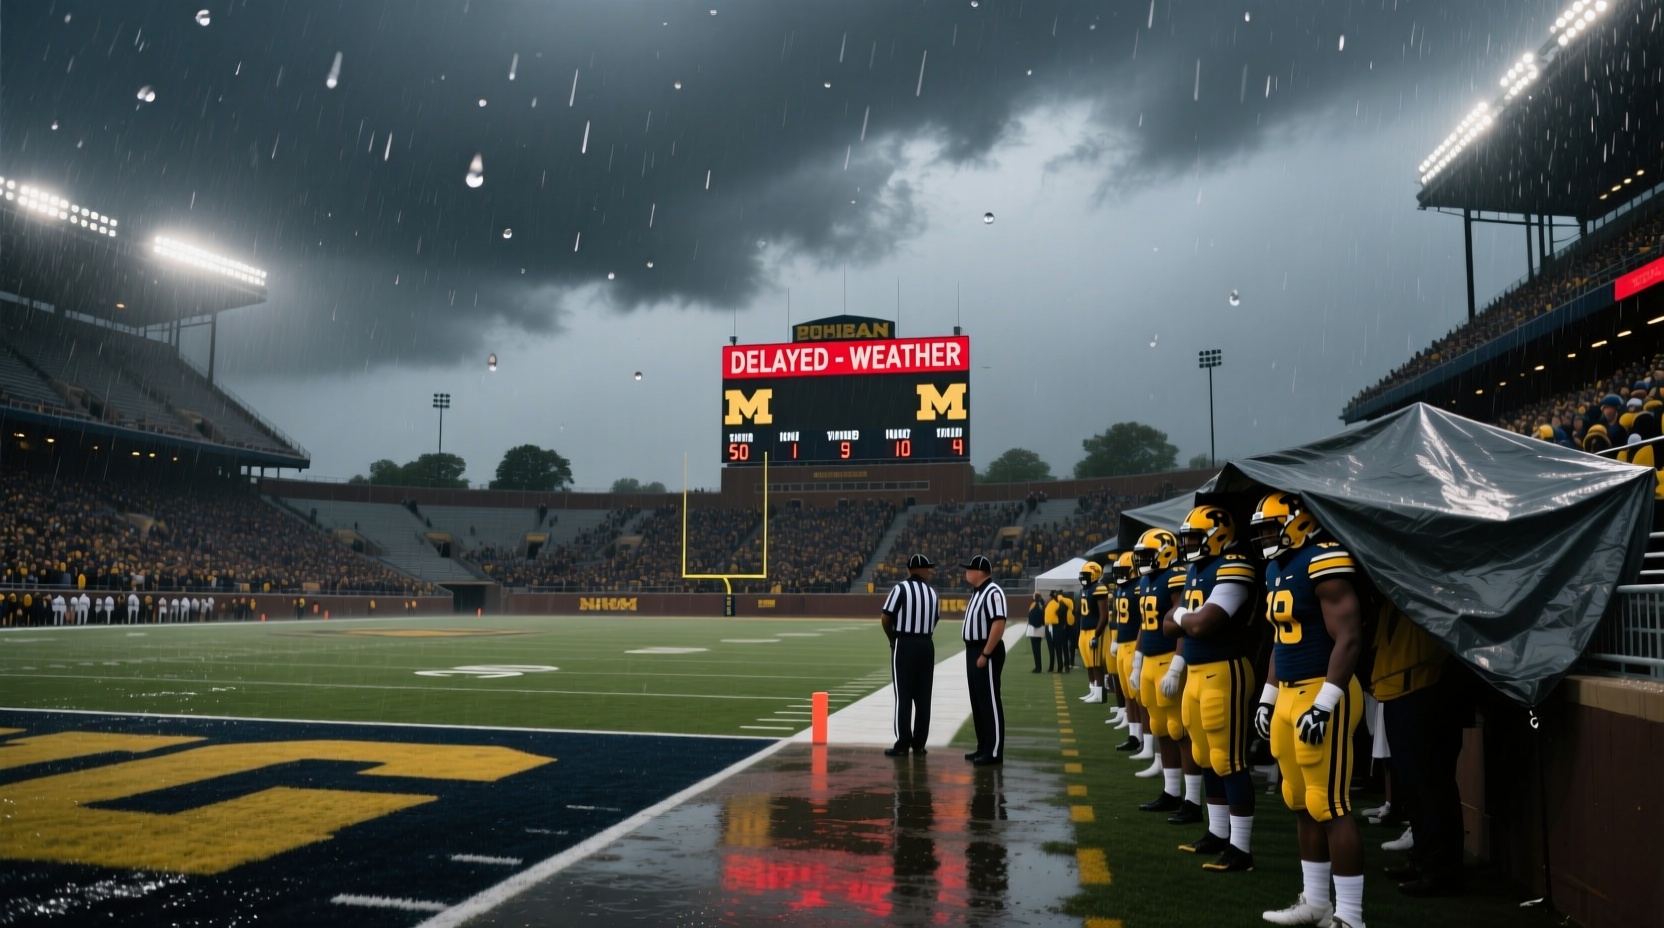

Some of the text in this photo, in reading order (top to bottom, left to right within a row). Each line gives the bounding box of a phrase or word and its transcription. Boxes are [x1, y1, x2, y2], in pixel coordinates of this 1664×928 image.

[731, 347, 829, 374] DELAYED
[850, 342, 961, 370] WEATHER
[724, 388, 773, 425] M
[916, 383, 967, 421] M
[729, 443, 749, 460] 50
[841, 441, 851, 459] 9
[895, 440, 911, 457] 10
[952, 439, 963, 456] 4
